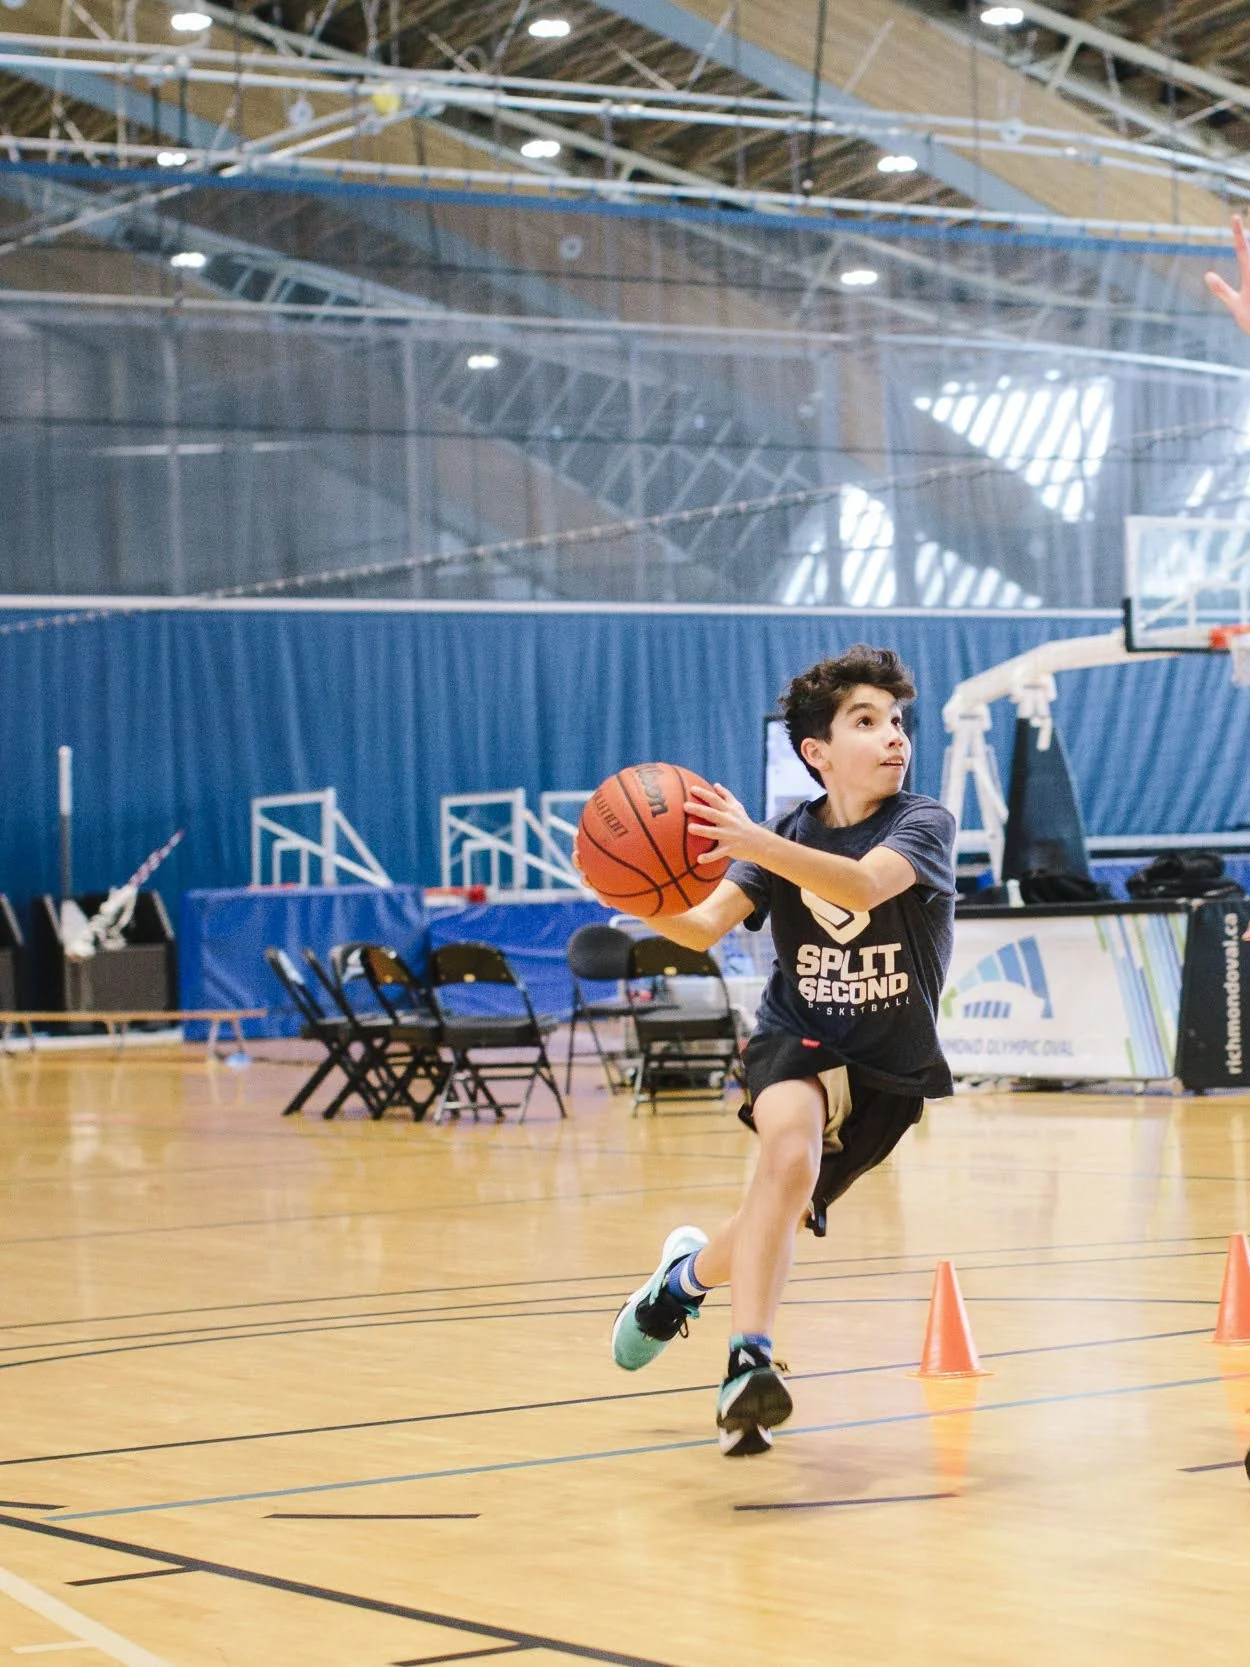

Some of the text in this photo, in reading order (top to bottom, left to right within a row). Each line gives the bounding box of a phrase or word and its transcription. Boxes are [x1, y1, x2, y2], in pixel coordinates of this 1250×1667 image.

[796, 942, 902, 981] SPLIT
[798, 971, 909, 1005] SECOND
[808, 996, 910, 1016] BSKETBALL
[1222, 912, 1243, 1075] richmondoval.ca
